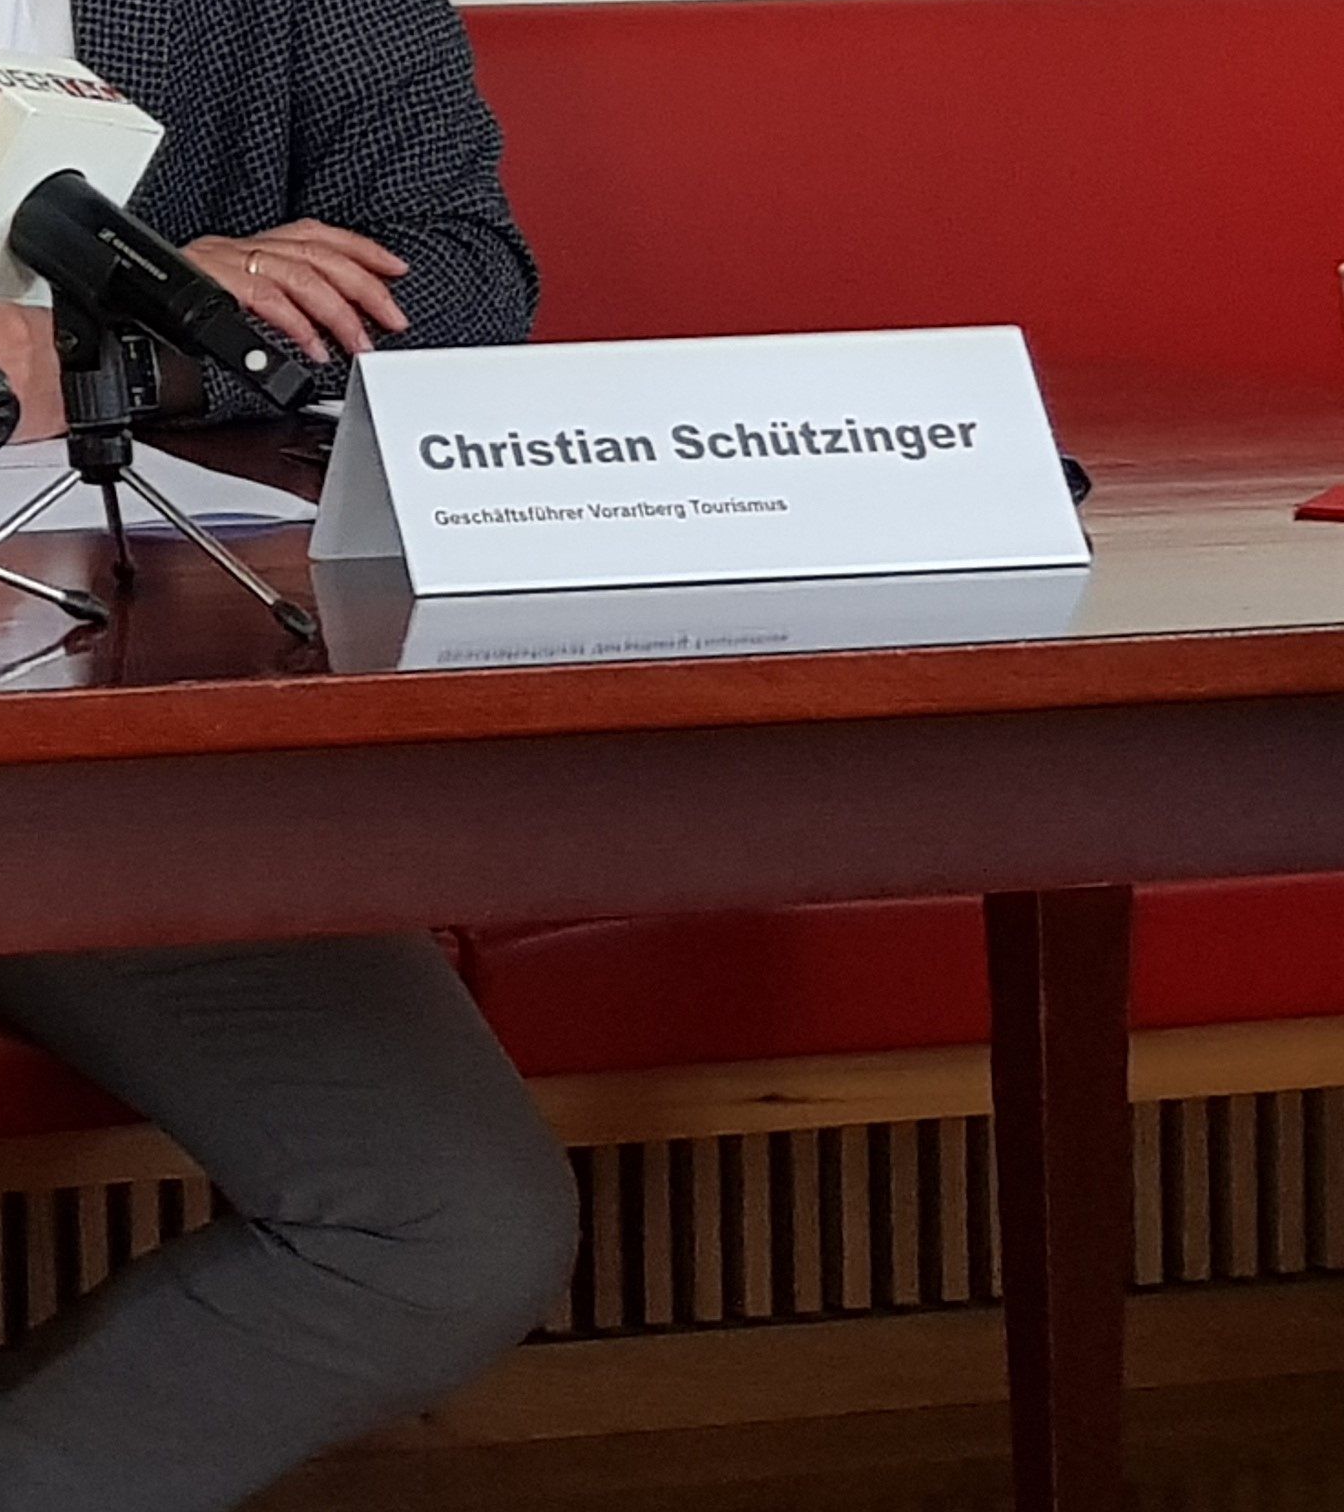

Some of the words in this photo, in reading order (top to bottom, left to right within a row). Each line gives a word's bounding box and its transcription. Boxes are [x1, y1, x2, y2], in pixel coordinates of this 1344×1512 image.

[418, 428, 657, 470] Christian
[671, 418, 977, 460] Schützinger
[434, 504, 584, 525] Geschäftsführer
[587, 499, 687, 519] Vorarlberg
[689, 497, 788, 515] Tourismus
